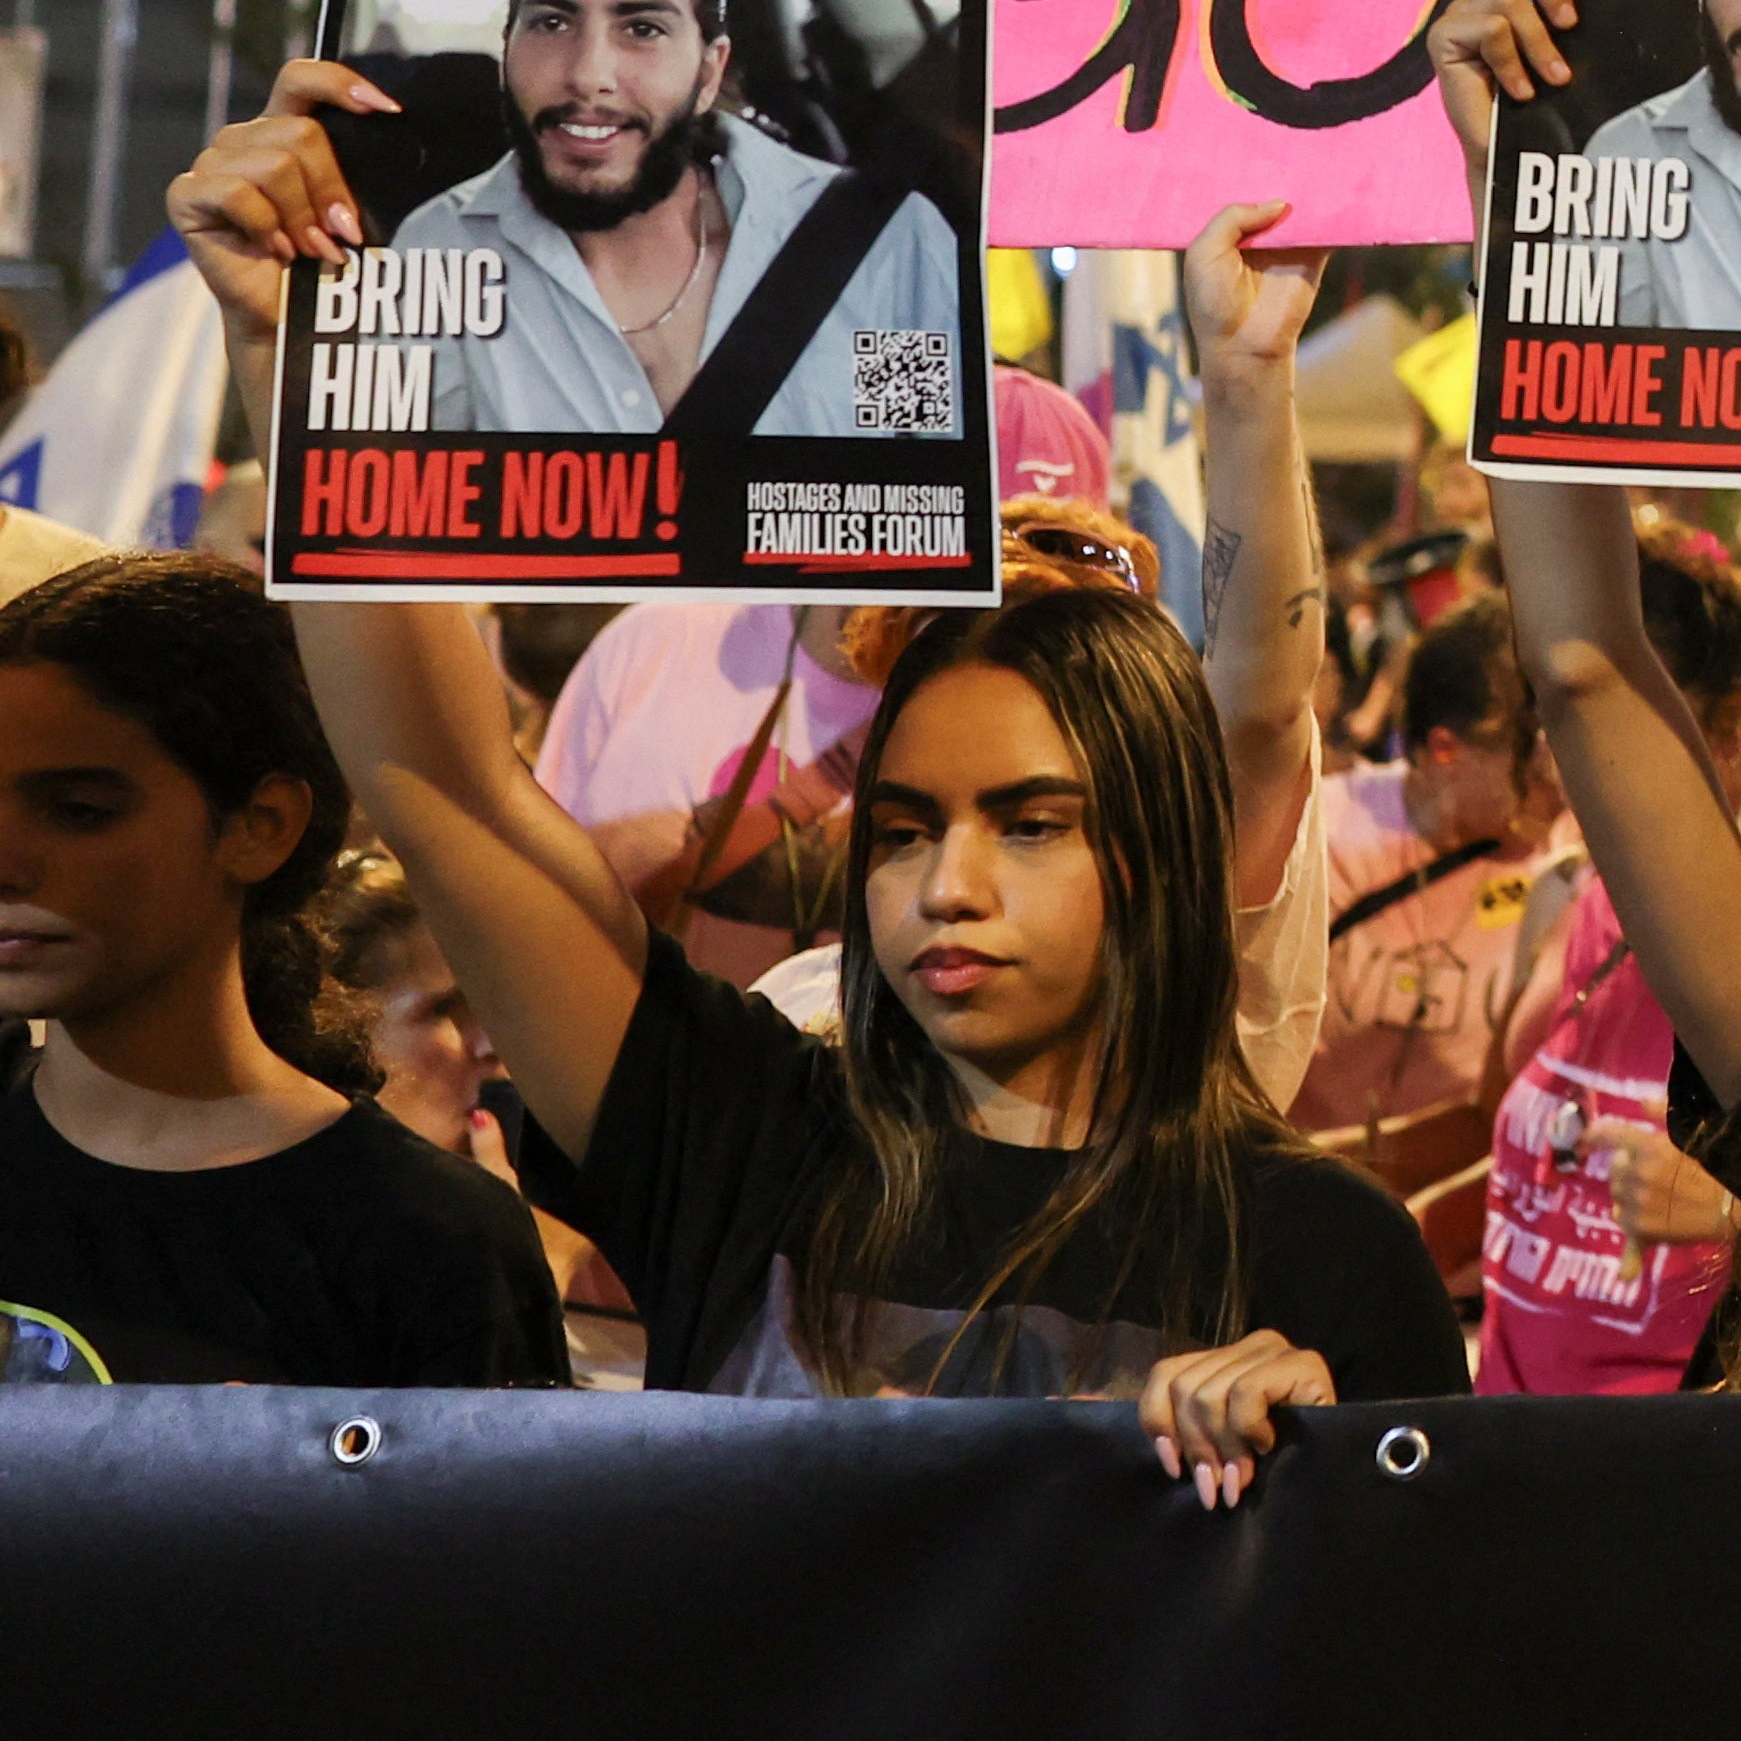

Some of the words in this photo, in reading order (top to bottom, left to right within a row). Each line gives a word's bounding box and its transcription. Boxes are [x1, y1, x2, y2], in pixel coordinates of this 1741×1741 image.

[1513, 151, 1690, 241] BRING
[314, 247, 505, 337] BRING
[1507, 241, 1620, 328] HIM
[306, 342, 434, 433] HIM
[1500, 339, 1667, 426] HOME
[301, 447, 487, 538] HOME
[500, 439, 684, 542] NOW!
[747, 481, 842, 513] HOSTAGES
[843, 483, 881, 513] AND
[883, 484, 965, 515] MISSING
[746, 512, 867, 556] FAMILIES
[872, 514, 965, 558] FORUM
